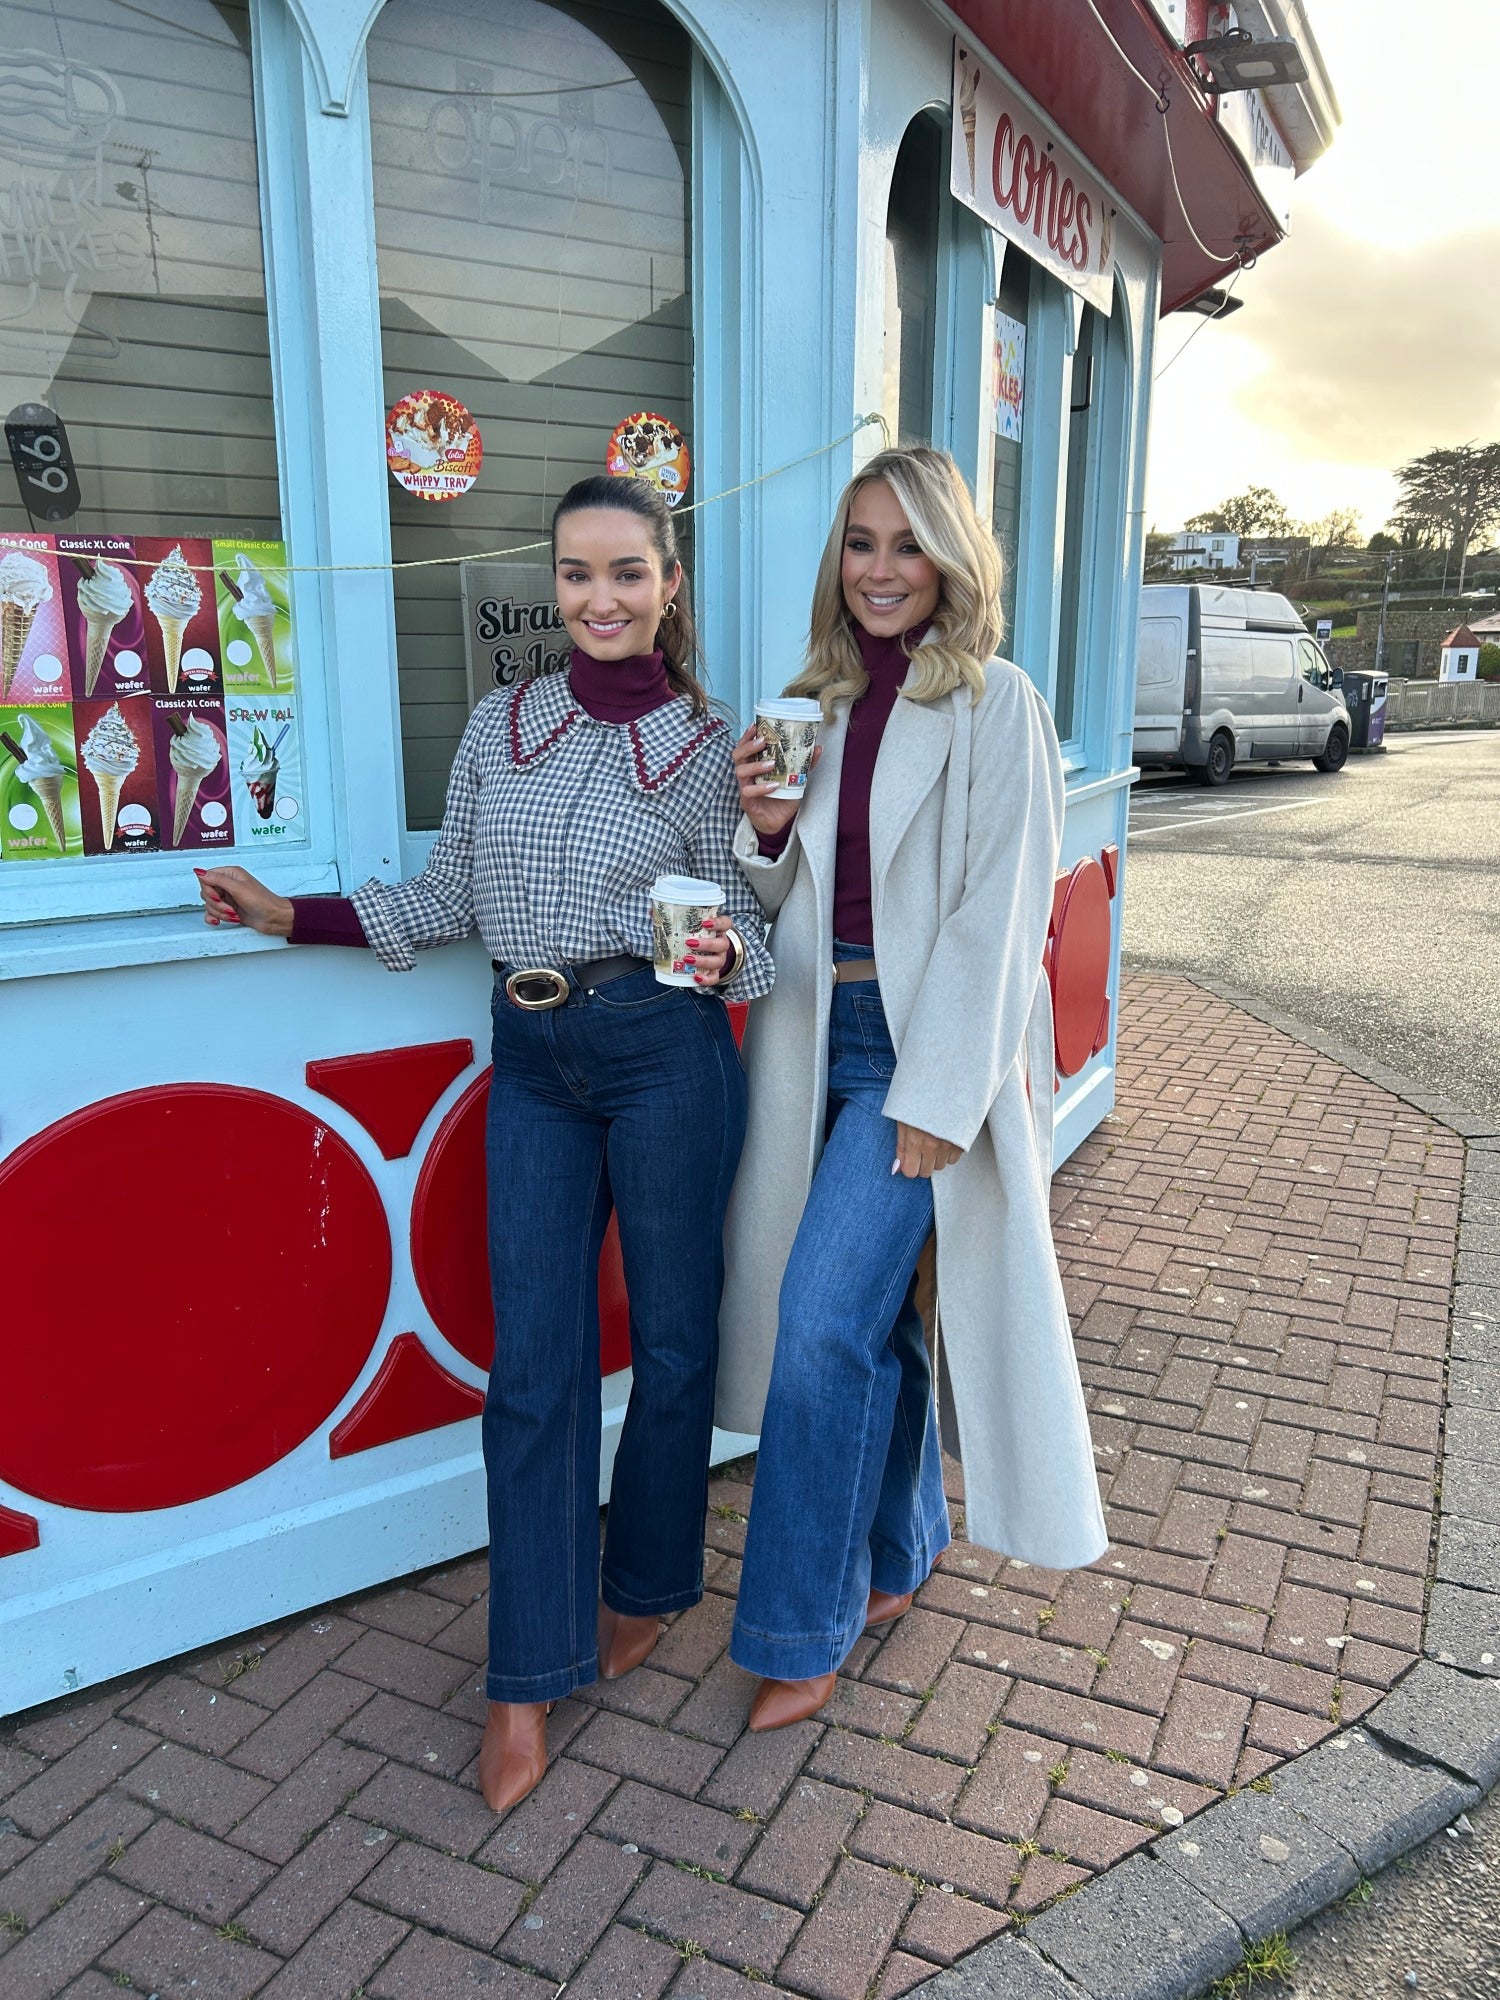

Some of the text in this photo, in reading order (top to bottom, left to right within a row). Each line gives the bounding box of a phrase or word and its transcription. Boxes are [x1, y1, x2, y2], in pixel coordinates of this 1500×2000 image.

[0, 226, 147, 281] HAKES
[996, 370, 1019, 404] KLES
[447, 449, 465, 460] Lotus
[433, 459, 474, 473] Biscoff
[444, 476, 469, 489] TRAY
[19, 538, 48, 550] Cone
[59, 539, 131, 550] Classic XL Cone
[214, 540, 280, 550] Small Classic Cone
[492, 647, 523, 687] &
[226, 671, 260, 682] wafer
[33, 684, 64, 694] wafer
[114, 680, 145, 690] wafer
[188, 684, 212, 692] wafer
[155, 699, 221, 709] Classic XL Cone
[228, 707, 295, 722] SCREW BALL
[201, 829, 229, 839] wafer
[251, 824, 287, 836] wafer
[8, 835, 48, 848] wafer
[124, 839, 148, 847] wafer
